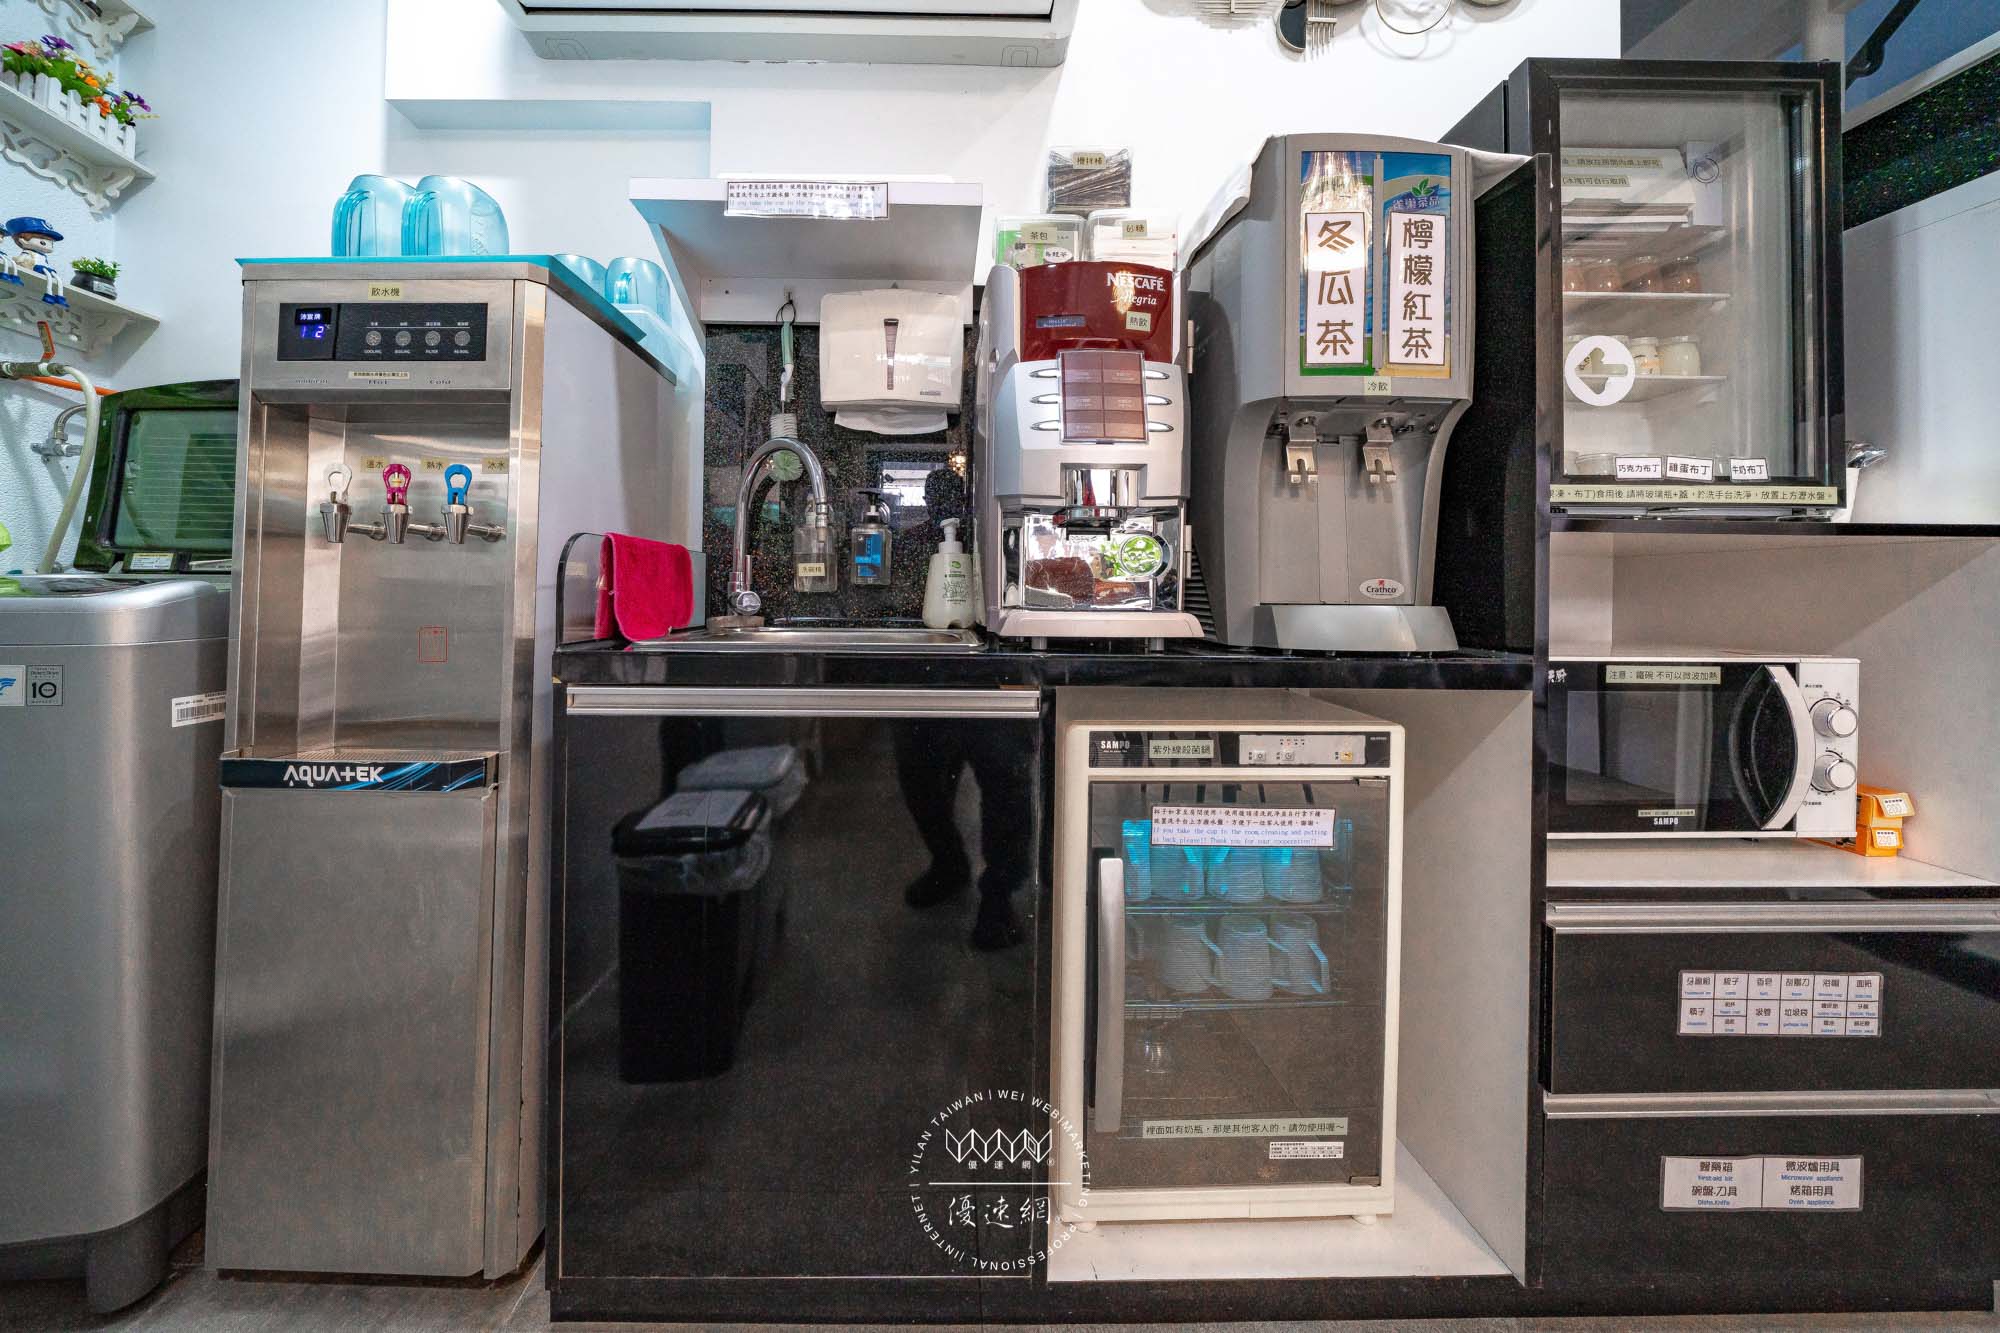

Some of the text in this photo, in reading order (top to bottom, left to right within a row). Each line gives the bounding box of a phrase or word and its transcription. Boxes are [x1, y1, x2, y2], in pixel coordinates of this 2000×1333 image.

[1030, 231, 1048, 241] 茶包
[1106, 272, 1165, 291] NESCAFÉ
[371, 287, 400, 297] 飲水機
[1316, 220, 1355, 356] 冬瓜茶
[1402, 218, 1433, 359] 檸檬紅茶
[1367, 380, 1389, 392] 冷飲
[1618, 463, 1659, 474] 巧克力布丁
[1668, 462, 1711, 476] 雞蛋布丁
[1732, 463, 1764, 475] 牛奶布丁
[1366, 585, 1397, 594] Crathco
[1100, 740, 1131, 749] SAMPO
[1653, 817, 1679, 825] SAMPO
[1700, 1161, 1733, 1173] 醫藥箱
[1785, 1161, 1841, 1173] 微波爐用具
[1790, 1185, 1834, 1197] 烤箱用具
